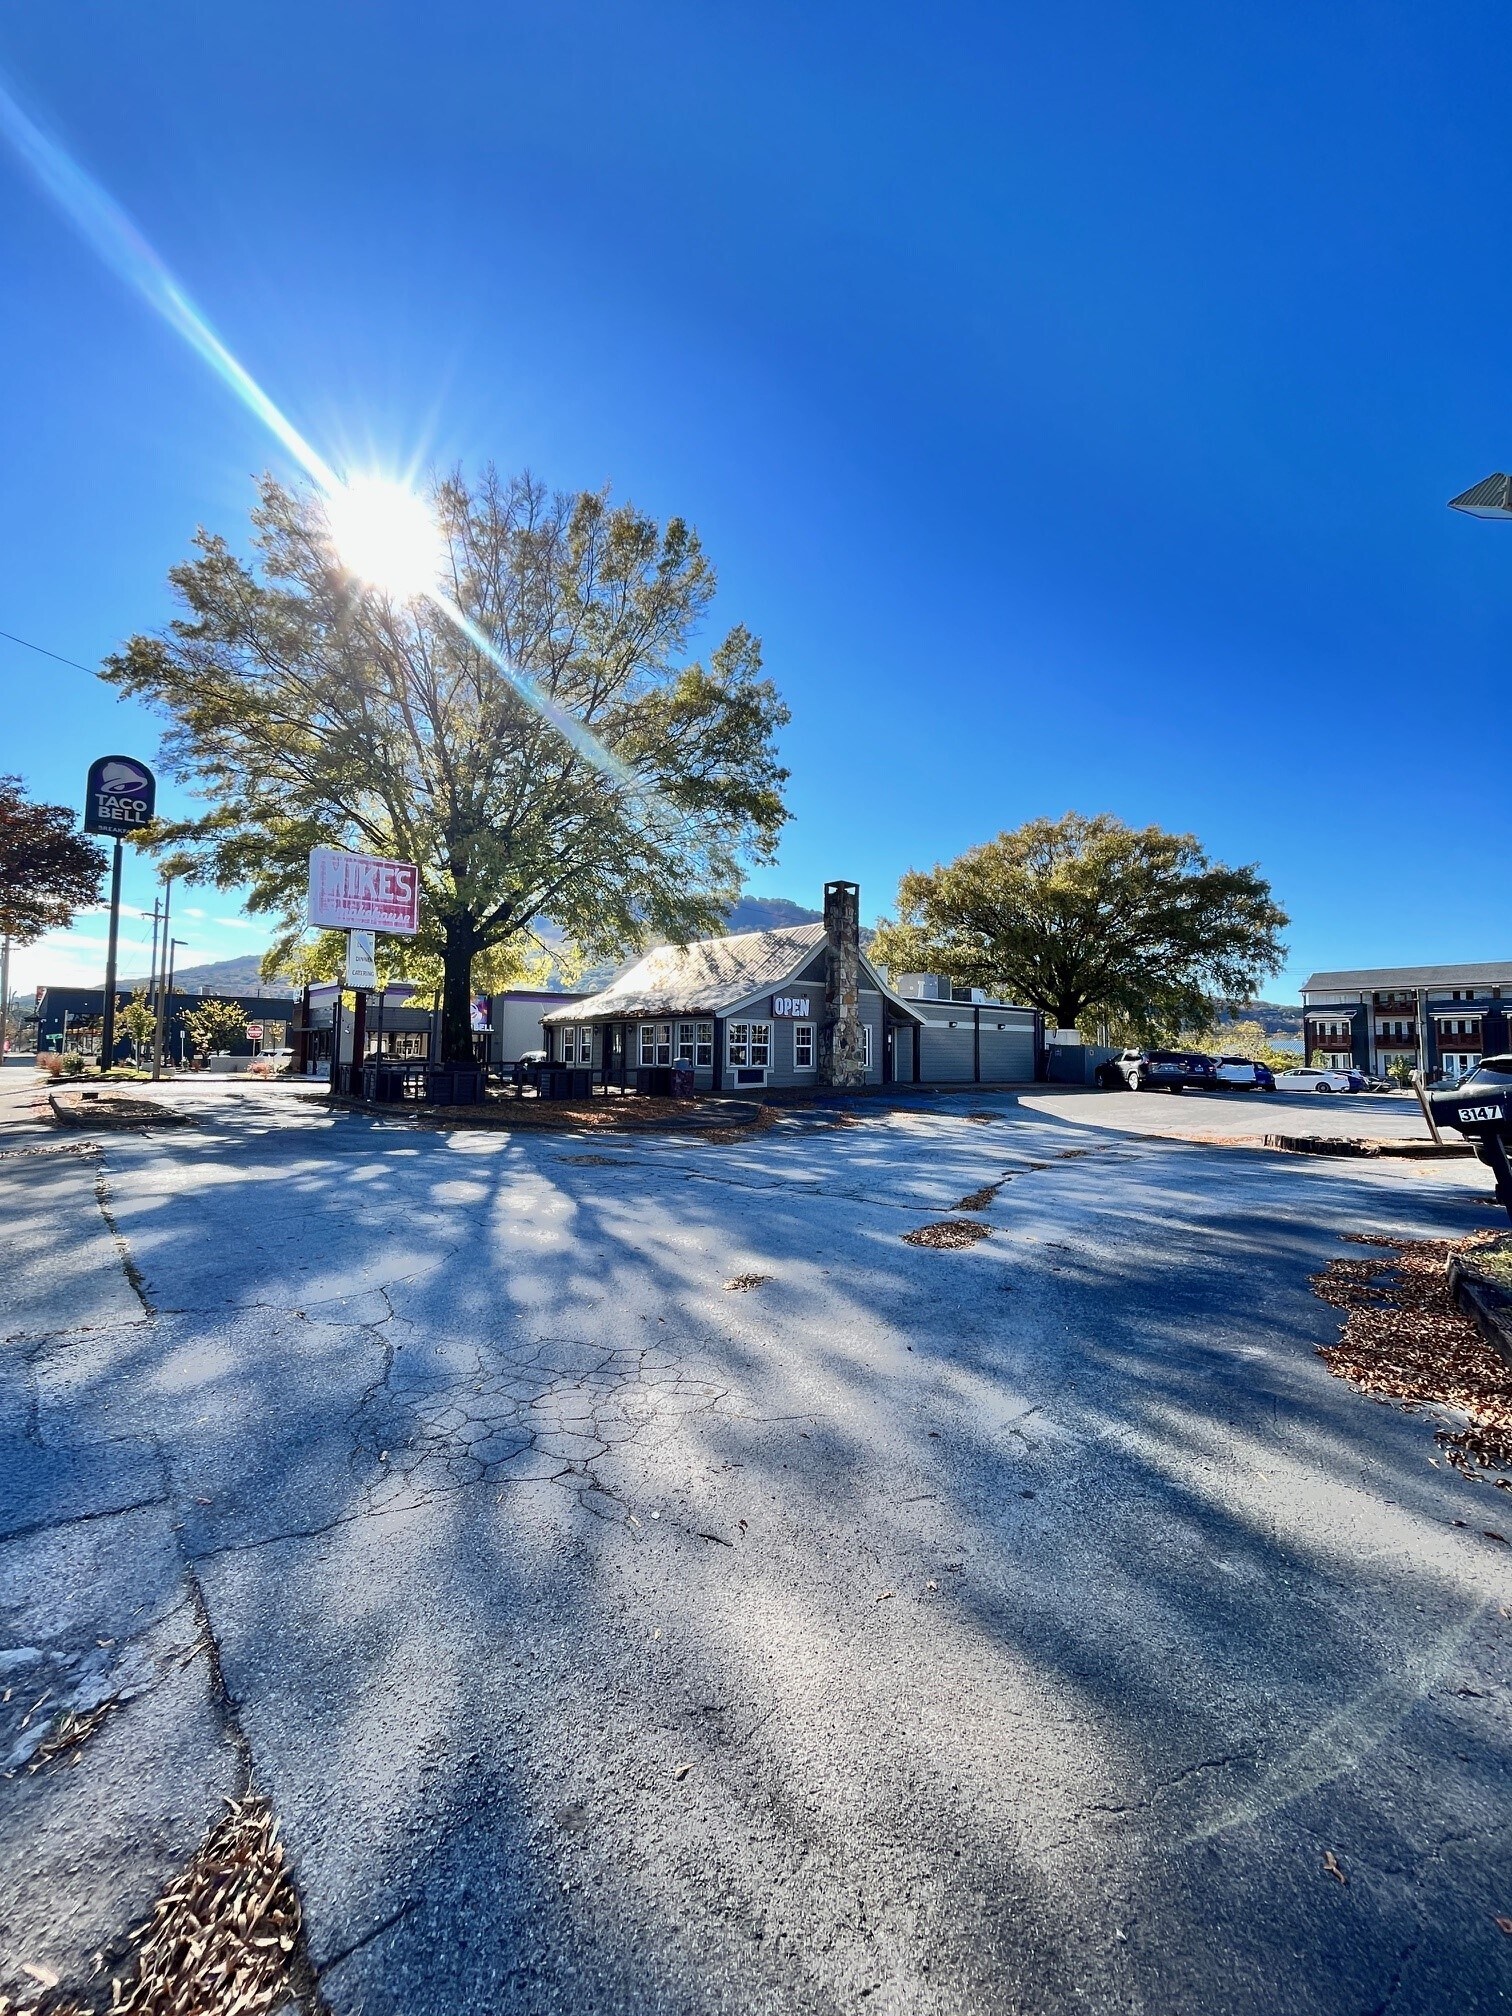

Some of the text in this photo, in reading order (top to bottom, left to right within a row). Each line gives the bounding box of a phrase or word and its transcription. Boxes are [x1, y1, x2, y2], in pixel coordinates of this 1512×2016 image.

[95, 794, 147, 811] TACO
[98, 806, 146, 823] BELL
[98, 825, 131, 834] BREAKFA
[323, 902, 411, 923] mokehouse
[775, 998, 810, 1016] OPEN
[1461, 1106, 1497, 1121] 3147
